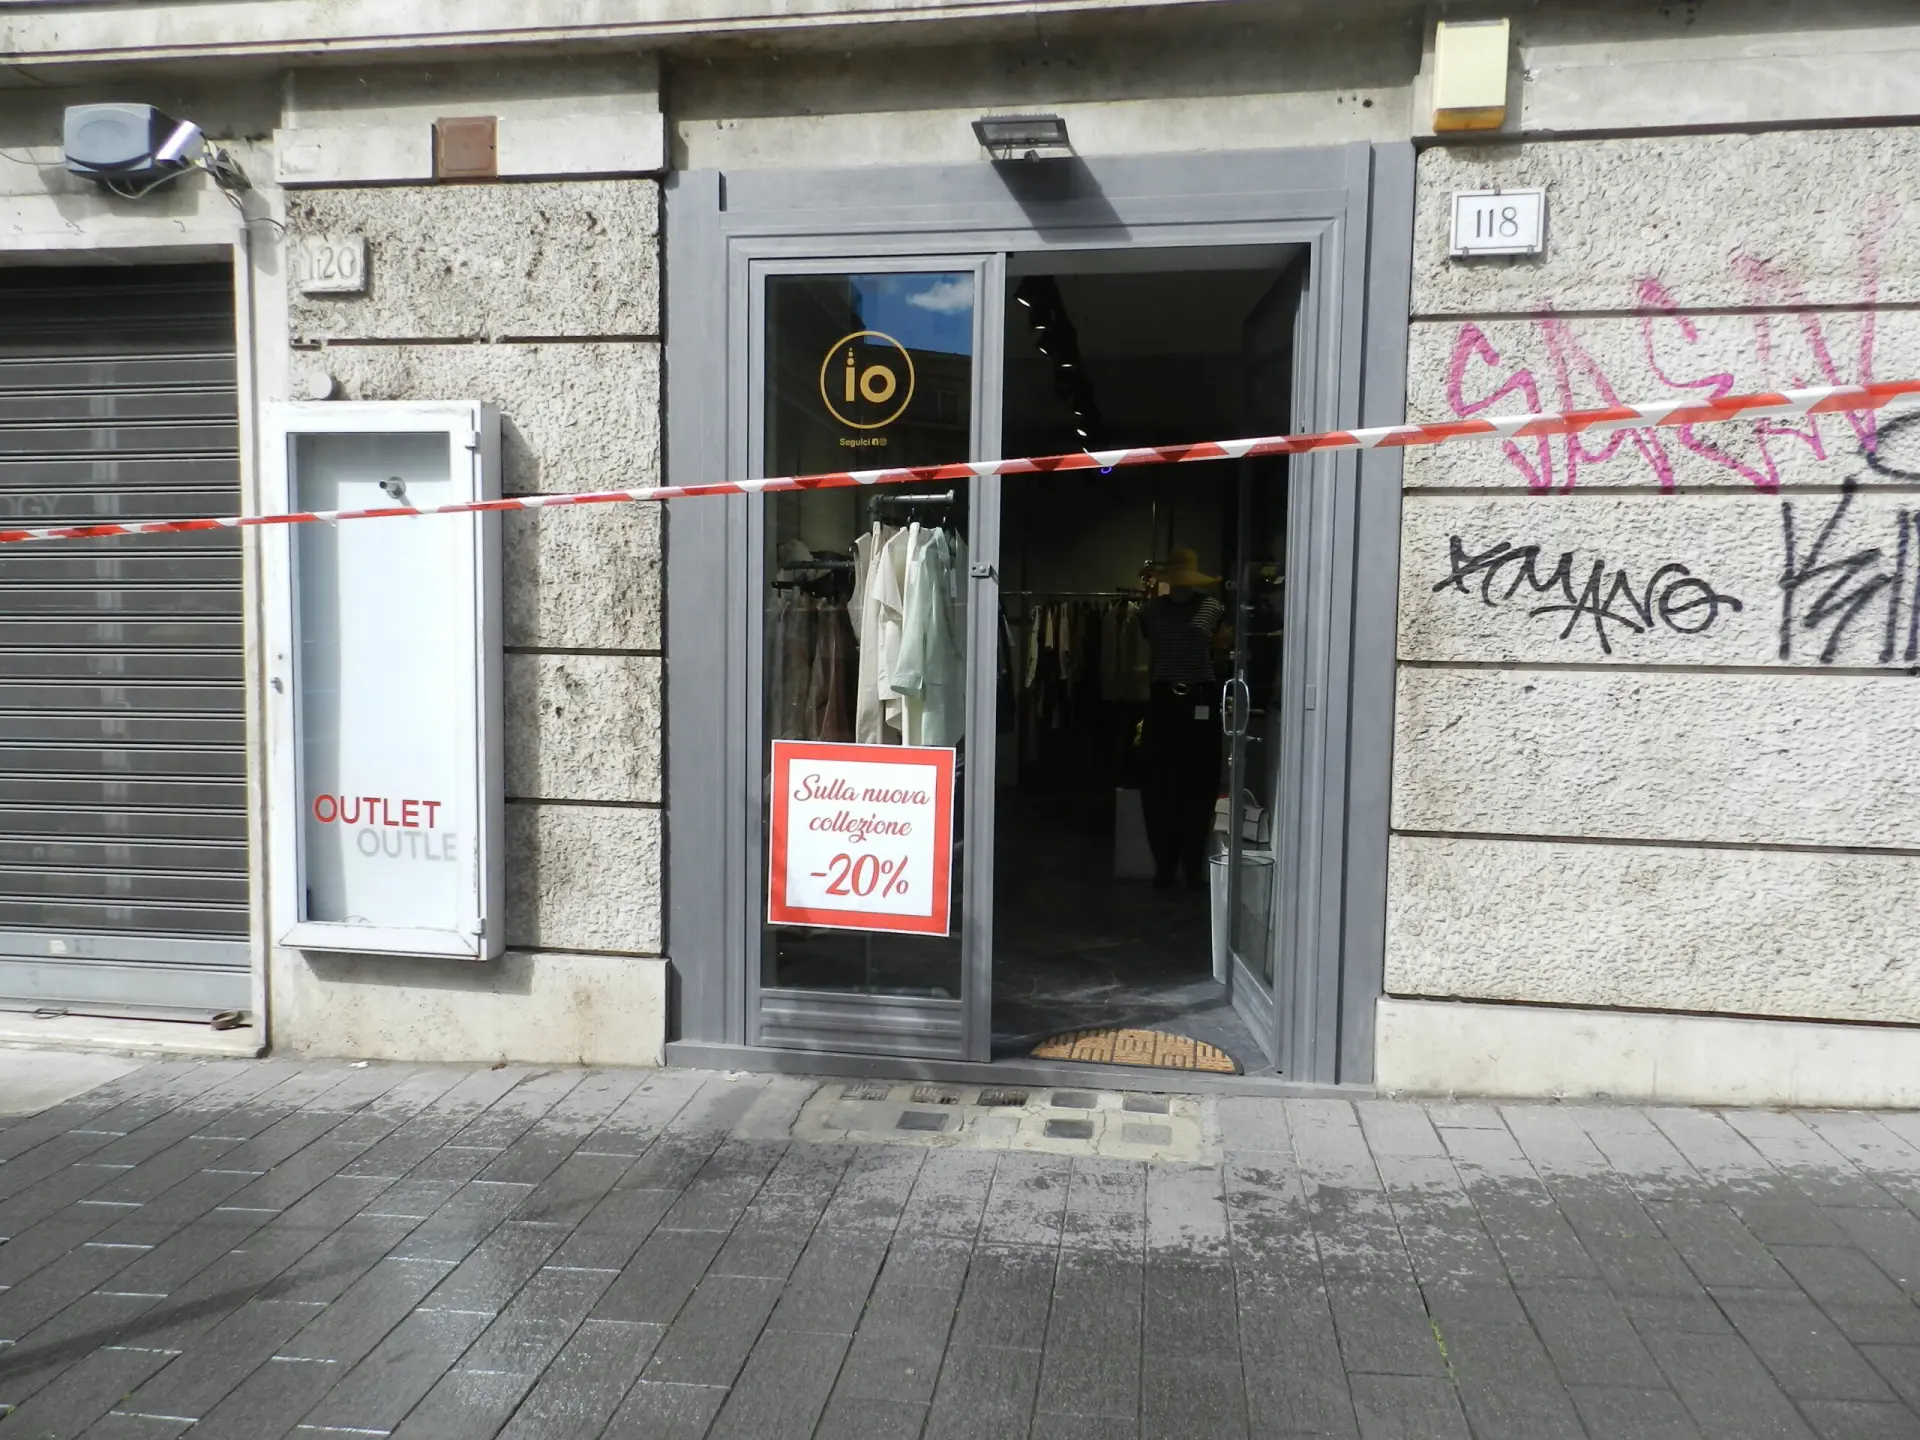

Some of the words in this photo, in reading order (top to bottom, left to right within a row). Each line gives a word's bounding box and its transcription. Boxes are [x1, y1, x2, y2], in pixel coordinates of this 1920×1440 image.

[1475, 206, 1519, 239] 118
[308, 245, 356, 280] 120
[845, 347, 897, 403] io
[839, 438, 871, 448] Seguici
[793, 773, 860, 802] Sulla
[862, 787, 931, 806] nuova
[312, 794, 442, 829] OUTLET
[809, 810, 913, 844] collezione
[810, 853, 909, 899] -20%
